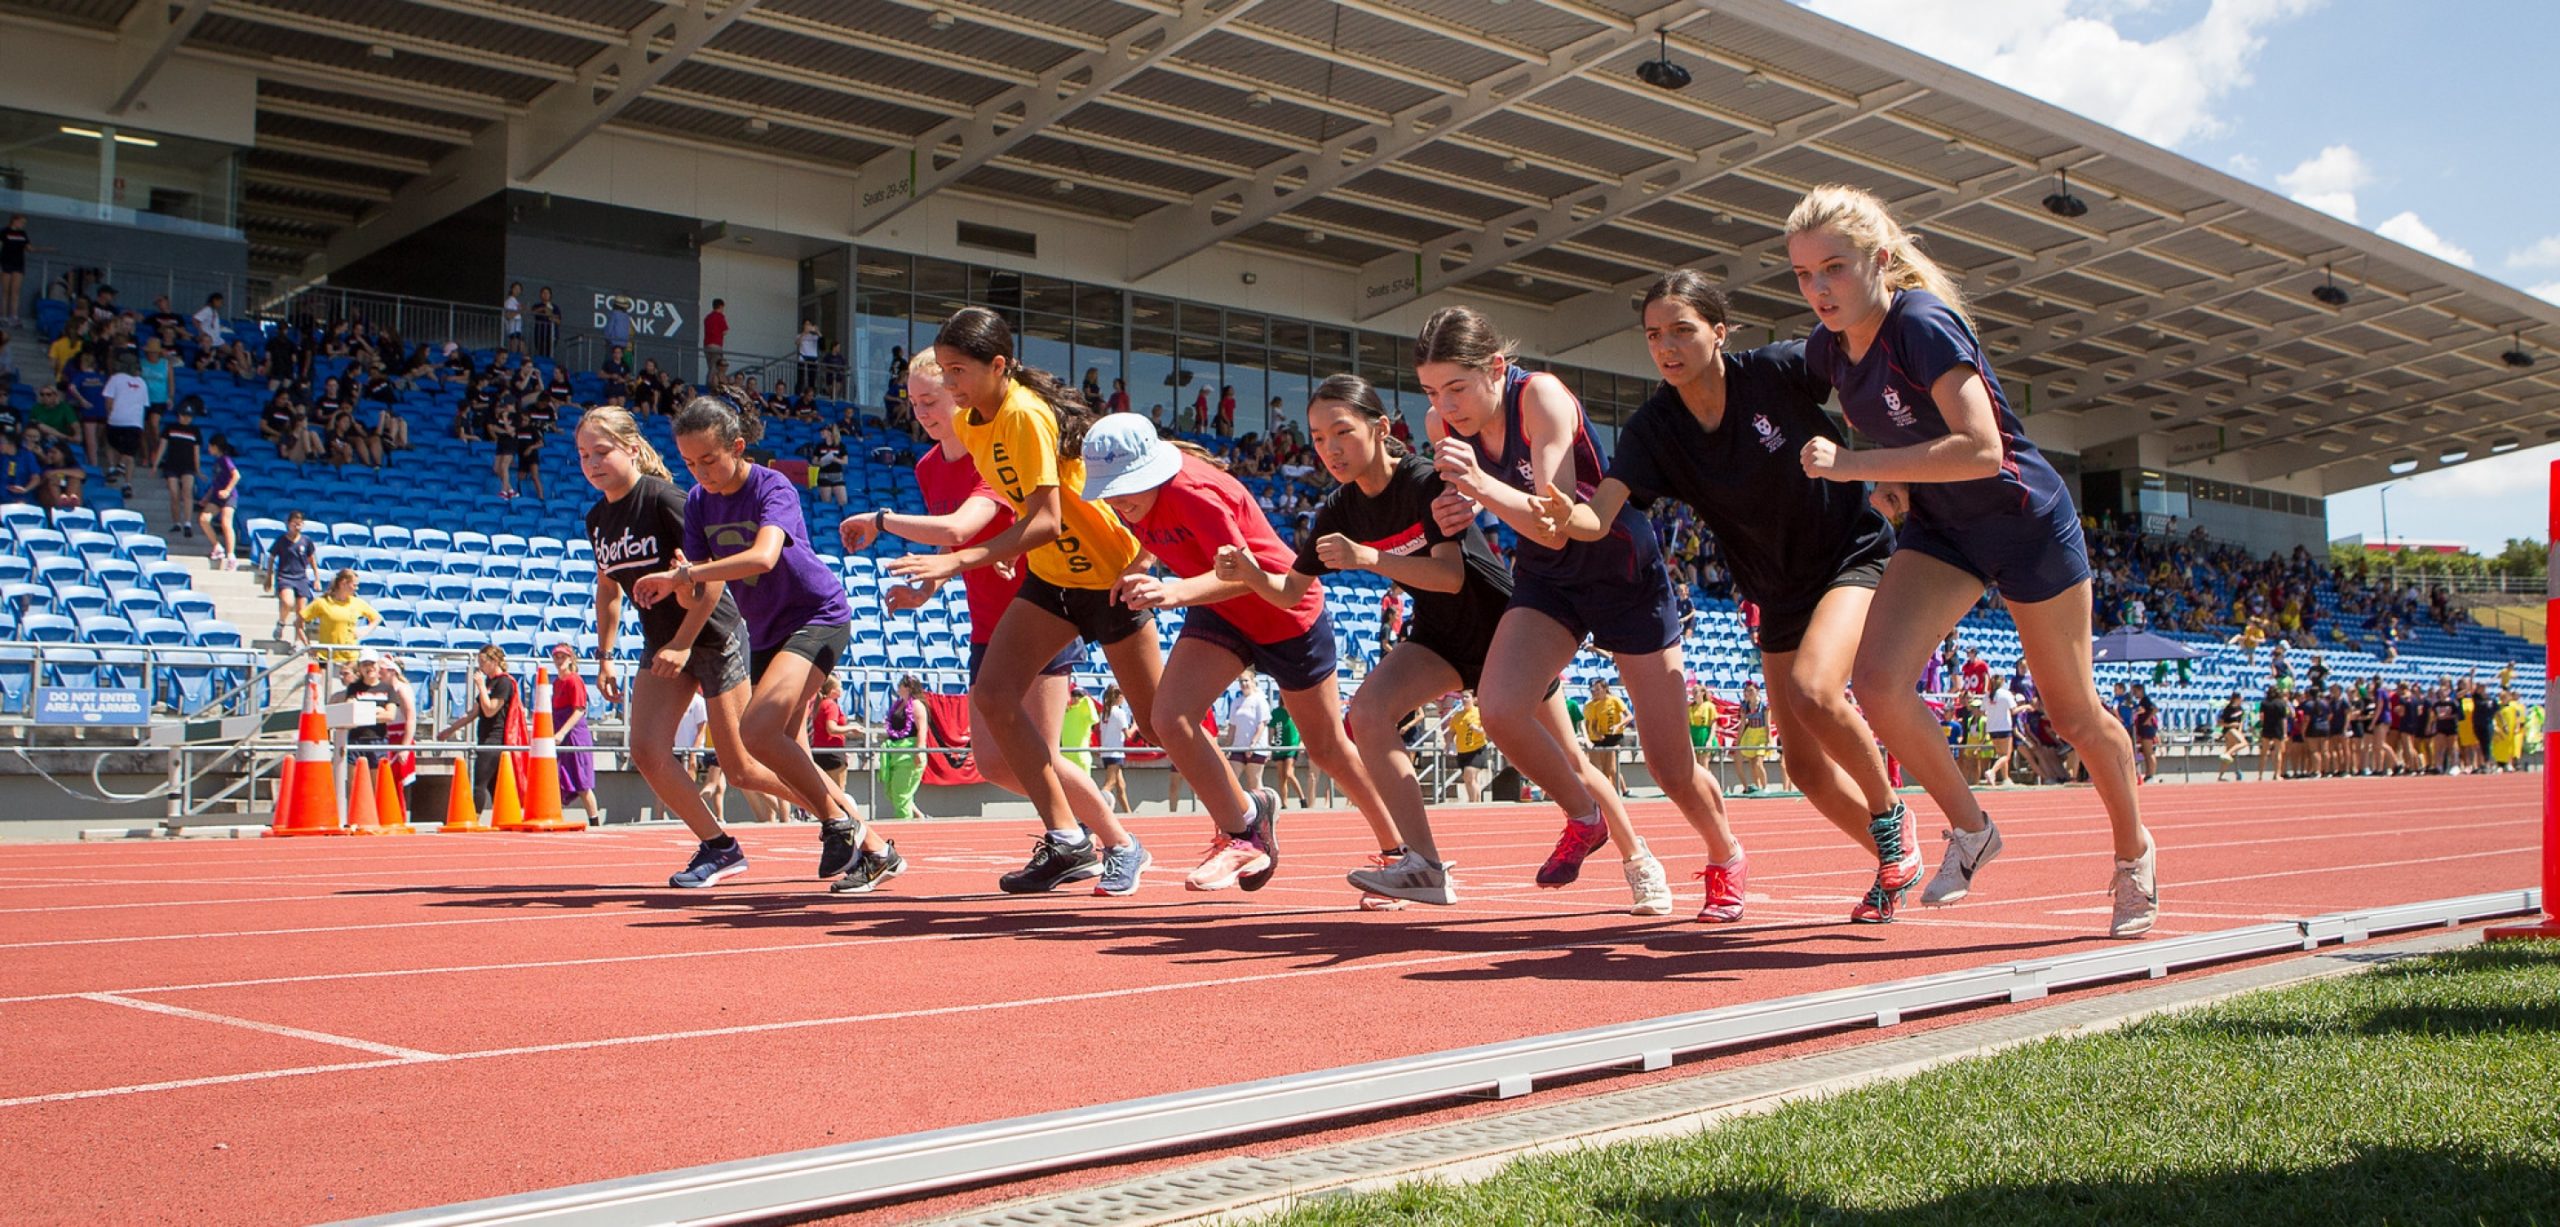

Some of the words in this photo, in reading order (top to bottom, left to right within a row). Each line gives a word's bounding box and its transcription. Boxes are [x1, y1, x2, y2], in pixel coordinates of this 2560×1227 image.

[862, 190, 885, 208] Seats
[653, 301, 665, 318] &
[593, 312, 656, 335] DNK
[48, 691, 69, 702] DO
[71, 691, 98, 702] NOT
[99, 692, 137, 703] ENTER
[44, 702, 79, 712] AREA
[81, 702, 141, 713] ALARMED
